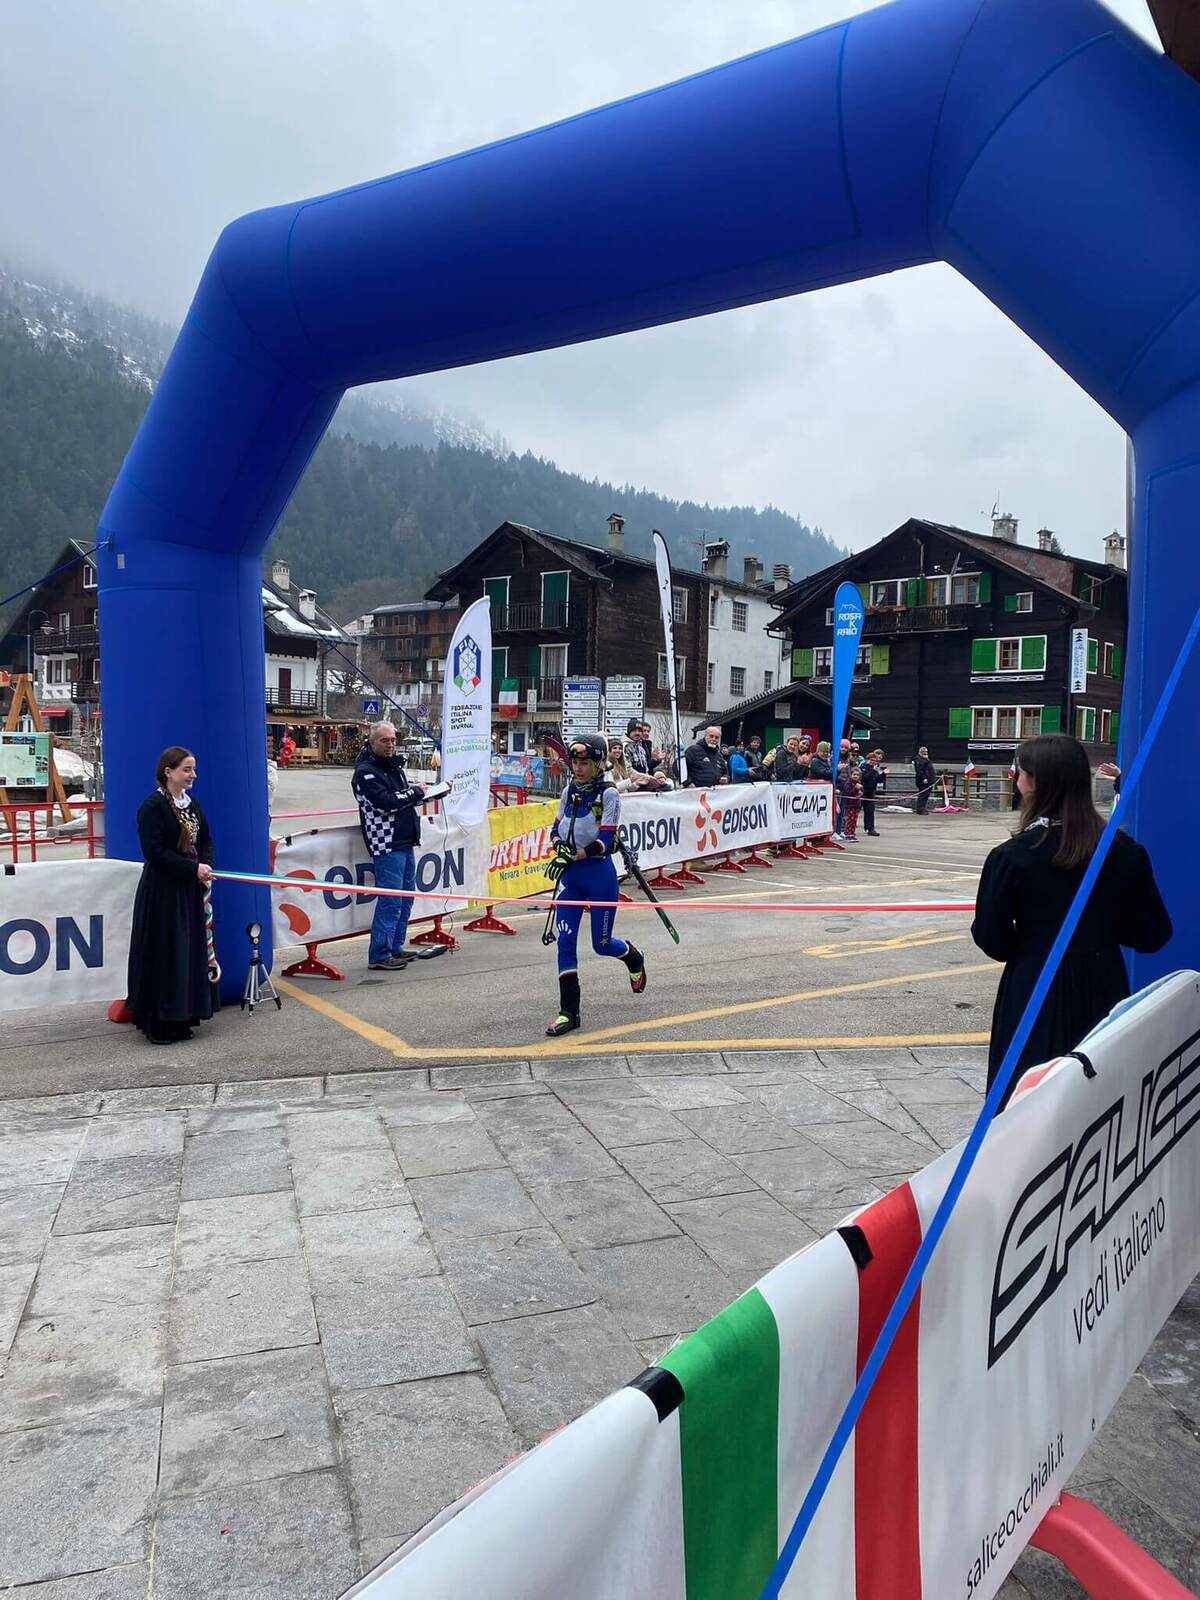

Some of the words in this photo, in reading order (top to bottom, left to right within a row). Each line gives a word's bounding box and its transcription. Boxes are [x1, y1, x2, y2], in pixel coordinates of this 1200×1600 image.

[838, 612, 862, 621] ROSA
[849, 620, 856, 628] K
[791, 794, 828, 817] CAMP
[1073, 1249, 1109, 1345] vedi
[1113, 1197, 1165, 1292] italiano
[967, 1431, 1064, 1600] saliceocchiali.it
